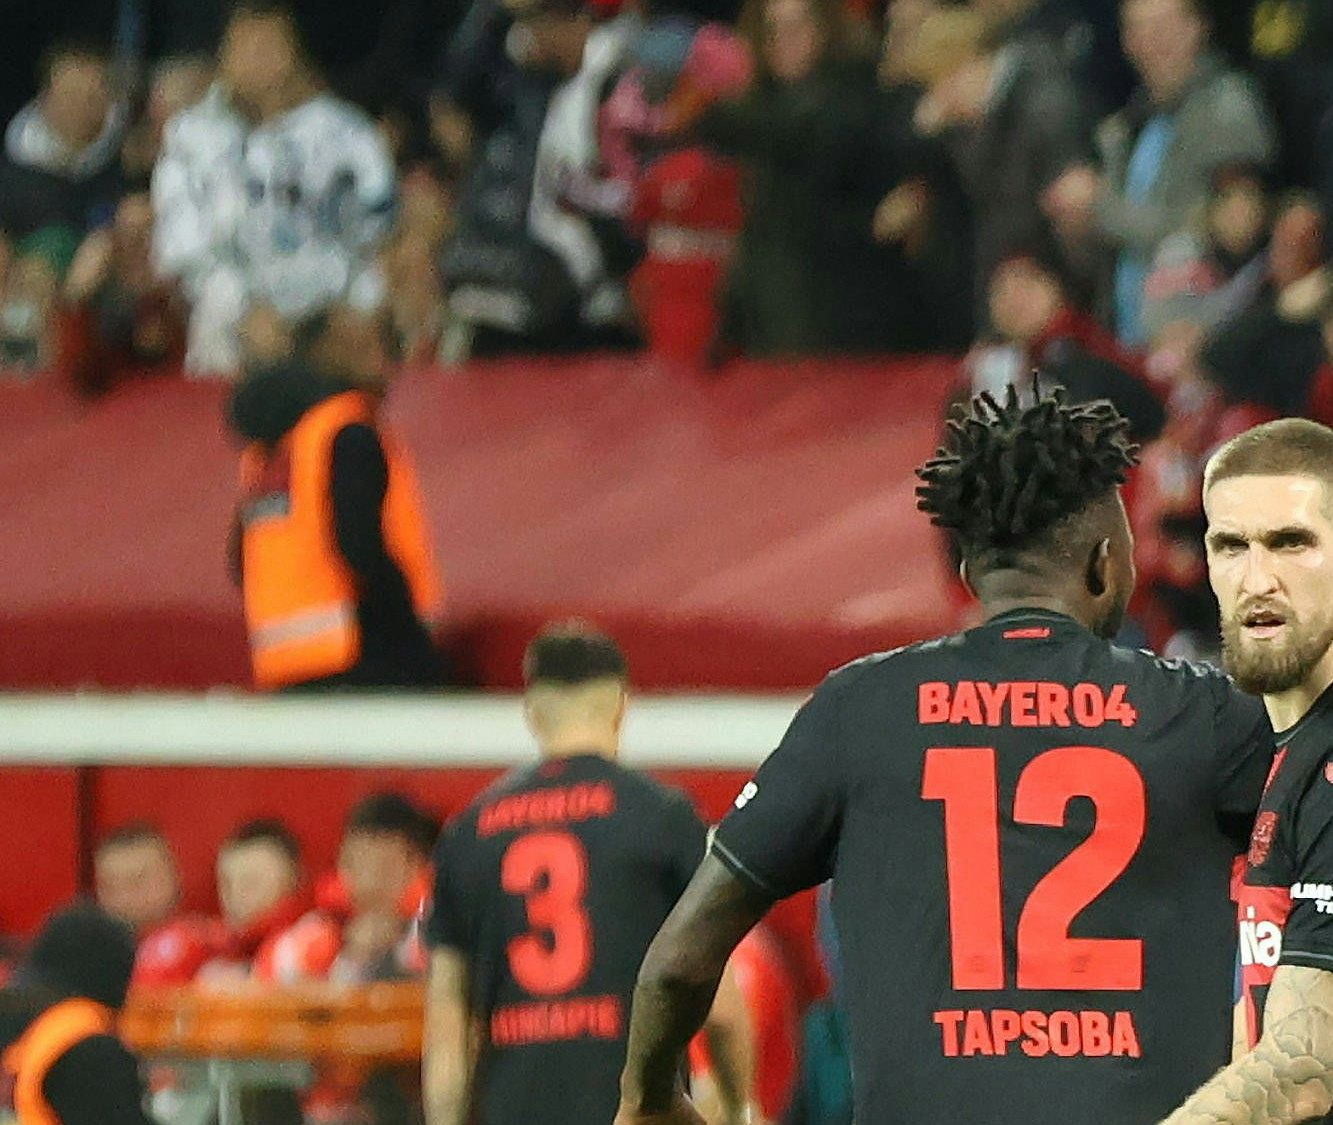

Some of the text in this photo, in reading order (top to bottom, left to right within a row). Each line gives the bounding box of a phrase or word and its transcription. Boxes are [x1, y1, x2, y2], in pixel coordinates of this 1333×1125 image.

[918, 680, 1138, 728] BAYER04
[501, 831, 595, 997] 3
[920, 745, 1147, 991] 12
[932, 1009, 1141, 1058] TAPSOBA
